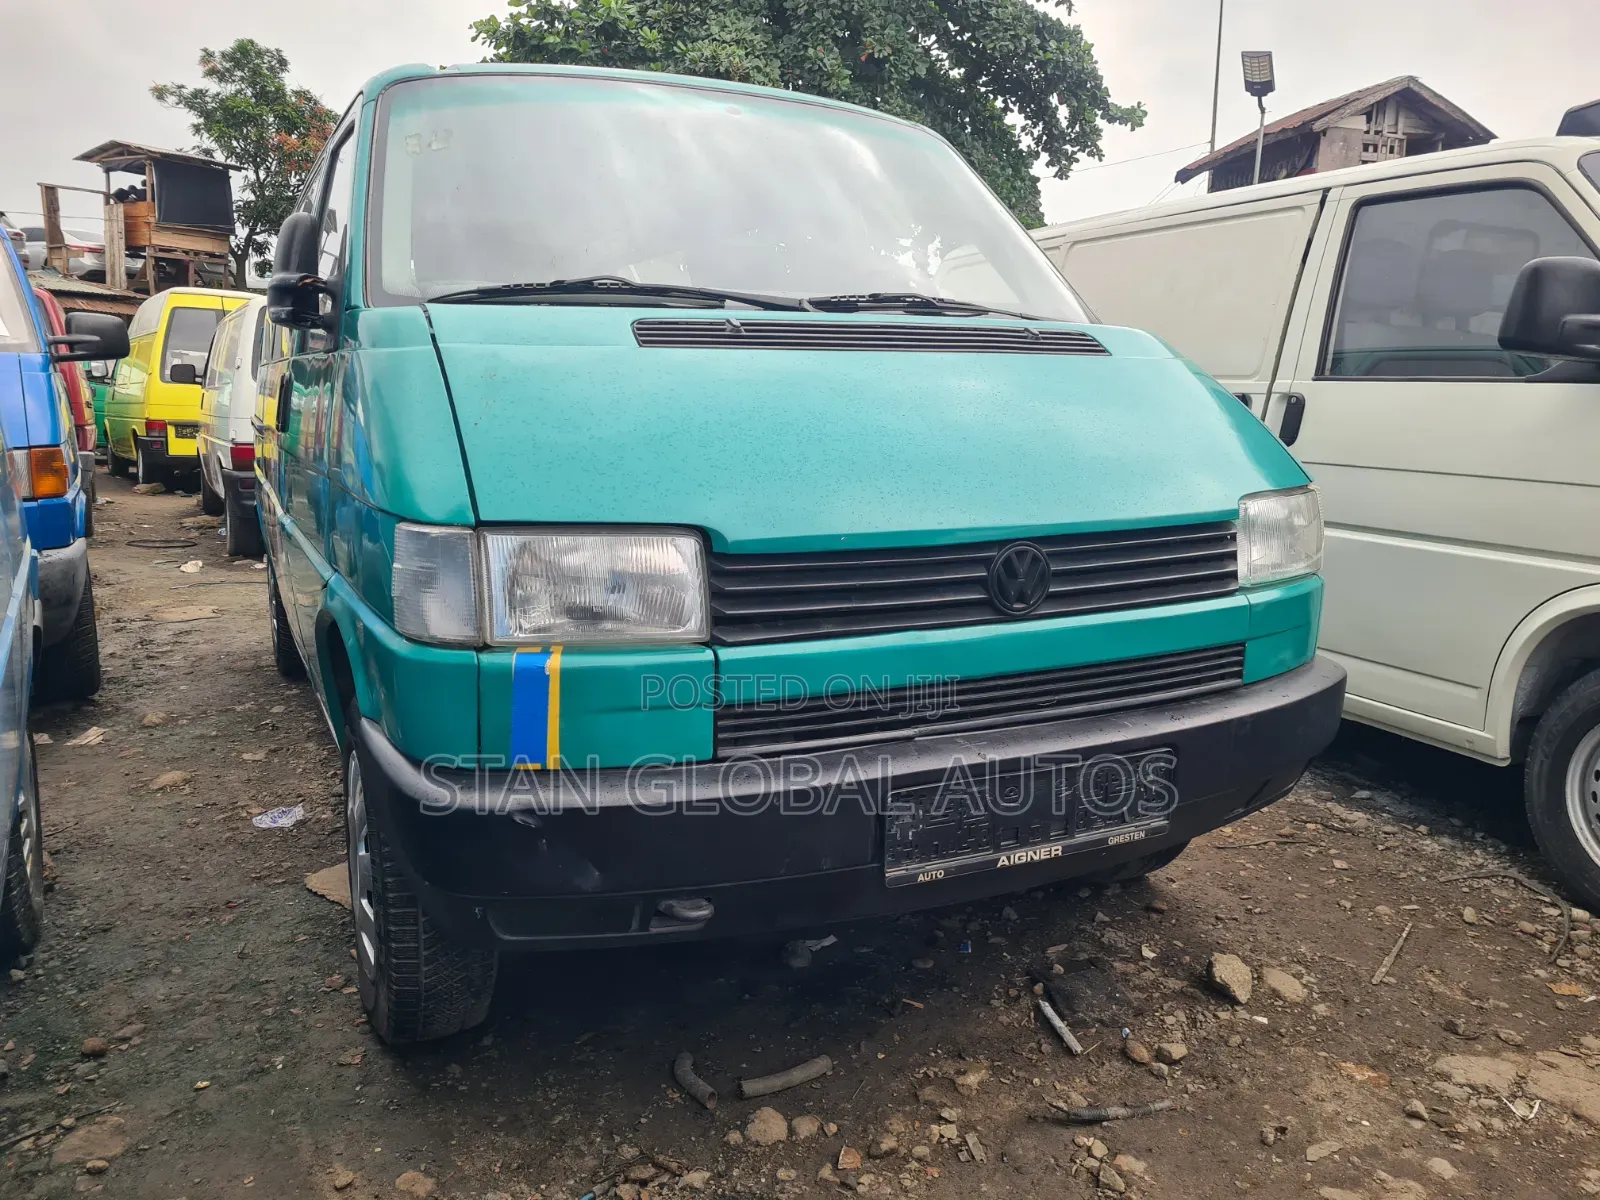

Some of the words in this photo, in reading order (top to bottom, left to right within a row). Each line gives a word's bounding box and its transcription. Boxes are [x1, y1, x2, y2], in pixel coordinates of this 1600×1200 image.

[991, 545, 1048, 611] VW
[917, 869, 945, 883] AUTO
[996, 845, 1063, 868] AIGNER
[1108, 830, 1146, 846] GRESTEN
